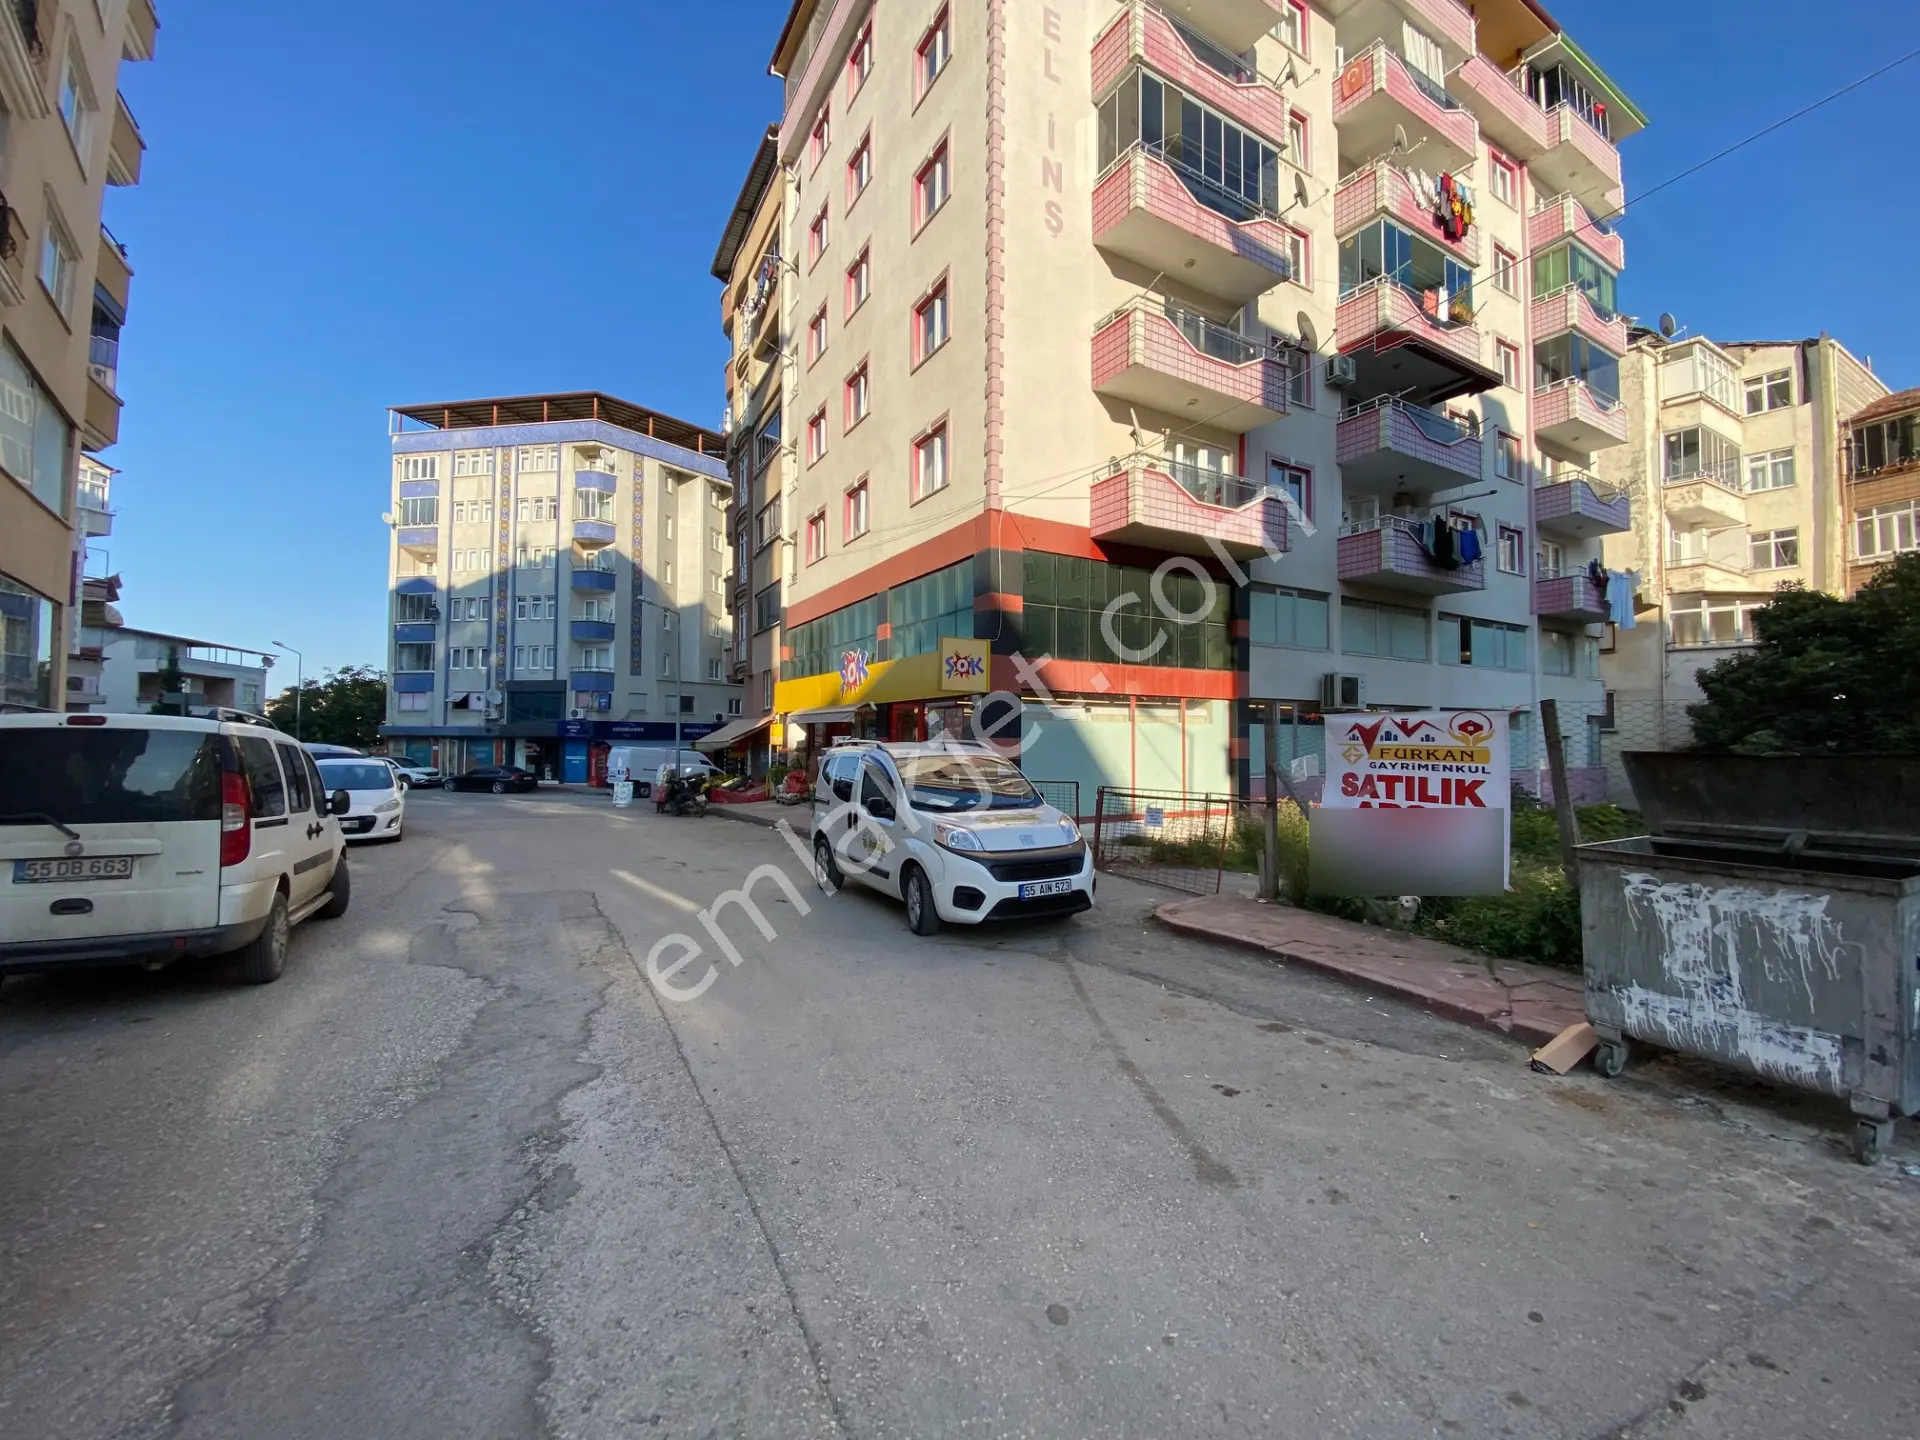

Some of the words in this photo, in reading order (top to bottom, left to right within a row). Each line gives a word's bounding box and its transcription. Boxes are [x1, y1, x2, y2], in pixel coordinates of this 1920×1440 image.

[838, 649, 870, 699] ŞOK
[944, 653, 985, 680] ŞOK
[1380, 748, 1475, 762] FURKAN
[1341, 772, 1487, 808] SATILIK
[25, 861, 52, 878] 55
[56, 860, 83, 877] DB
[90, 857, 129, 875] 663
[1024, 884, 1036, 897] 55
[1055, 880, 1070, 892] 523
